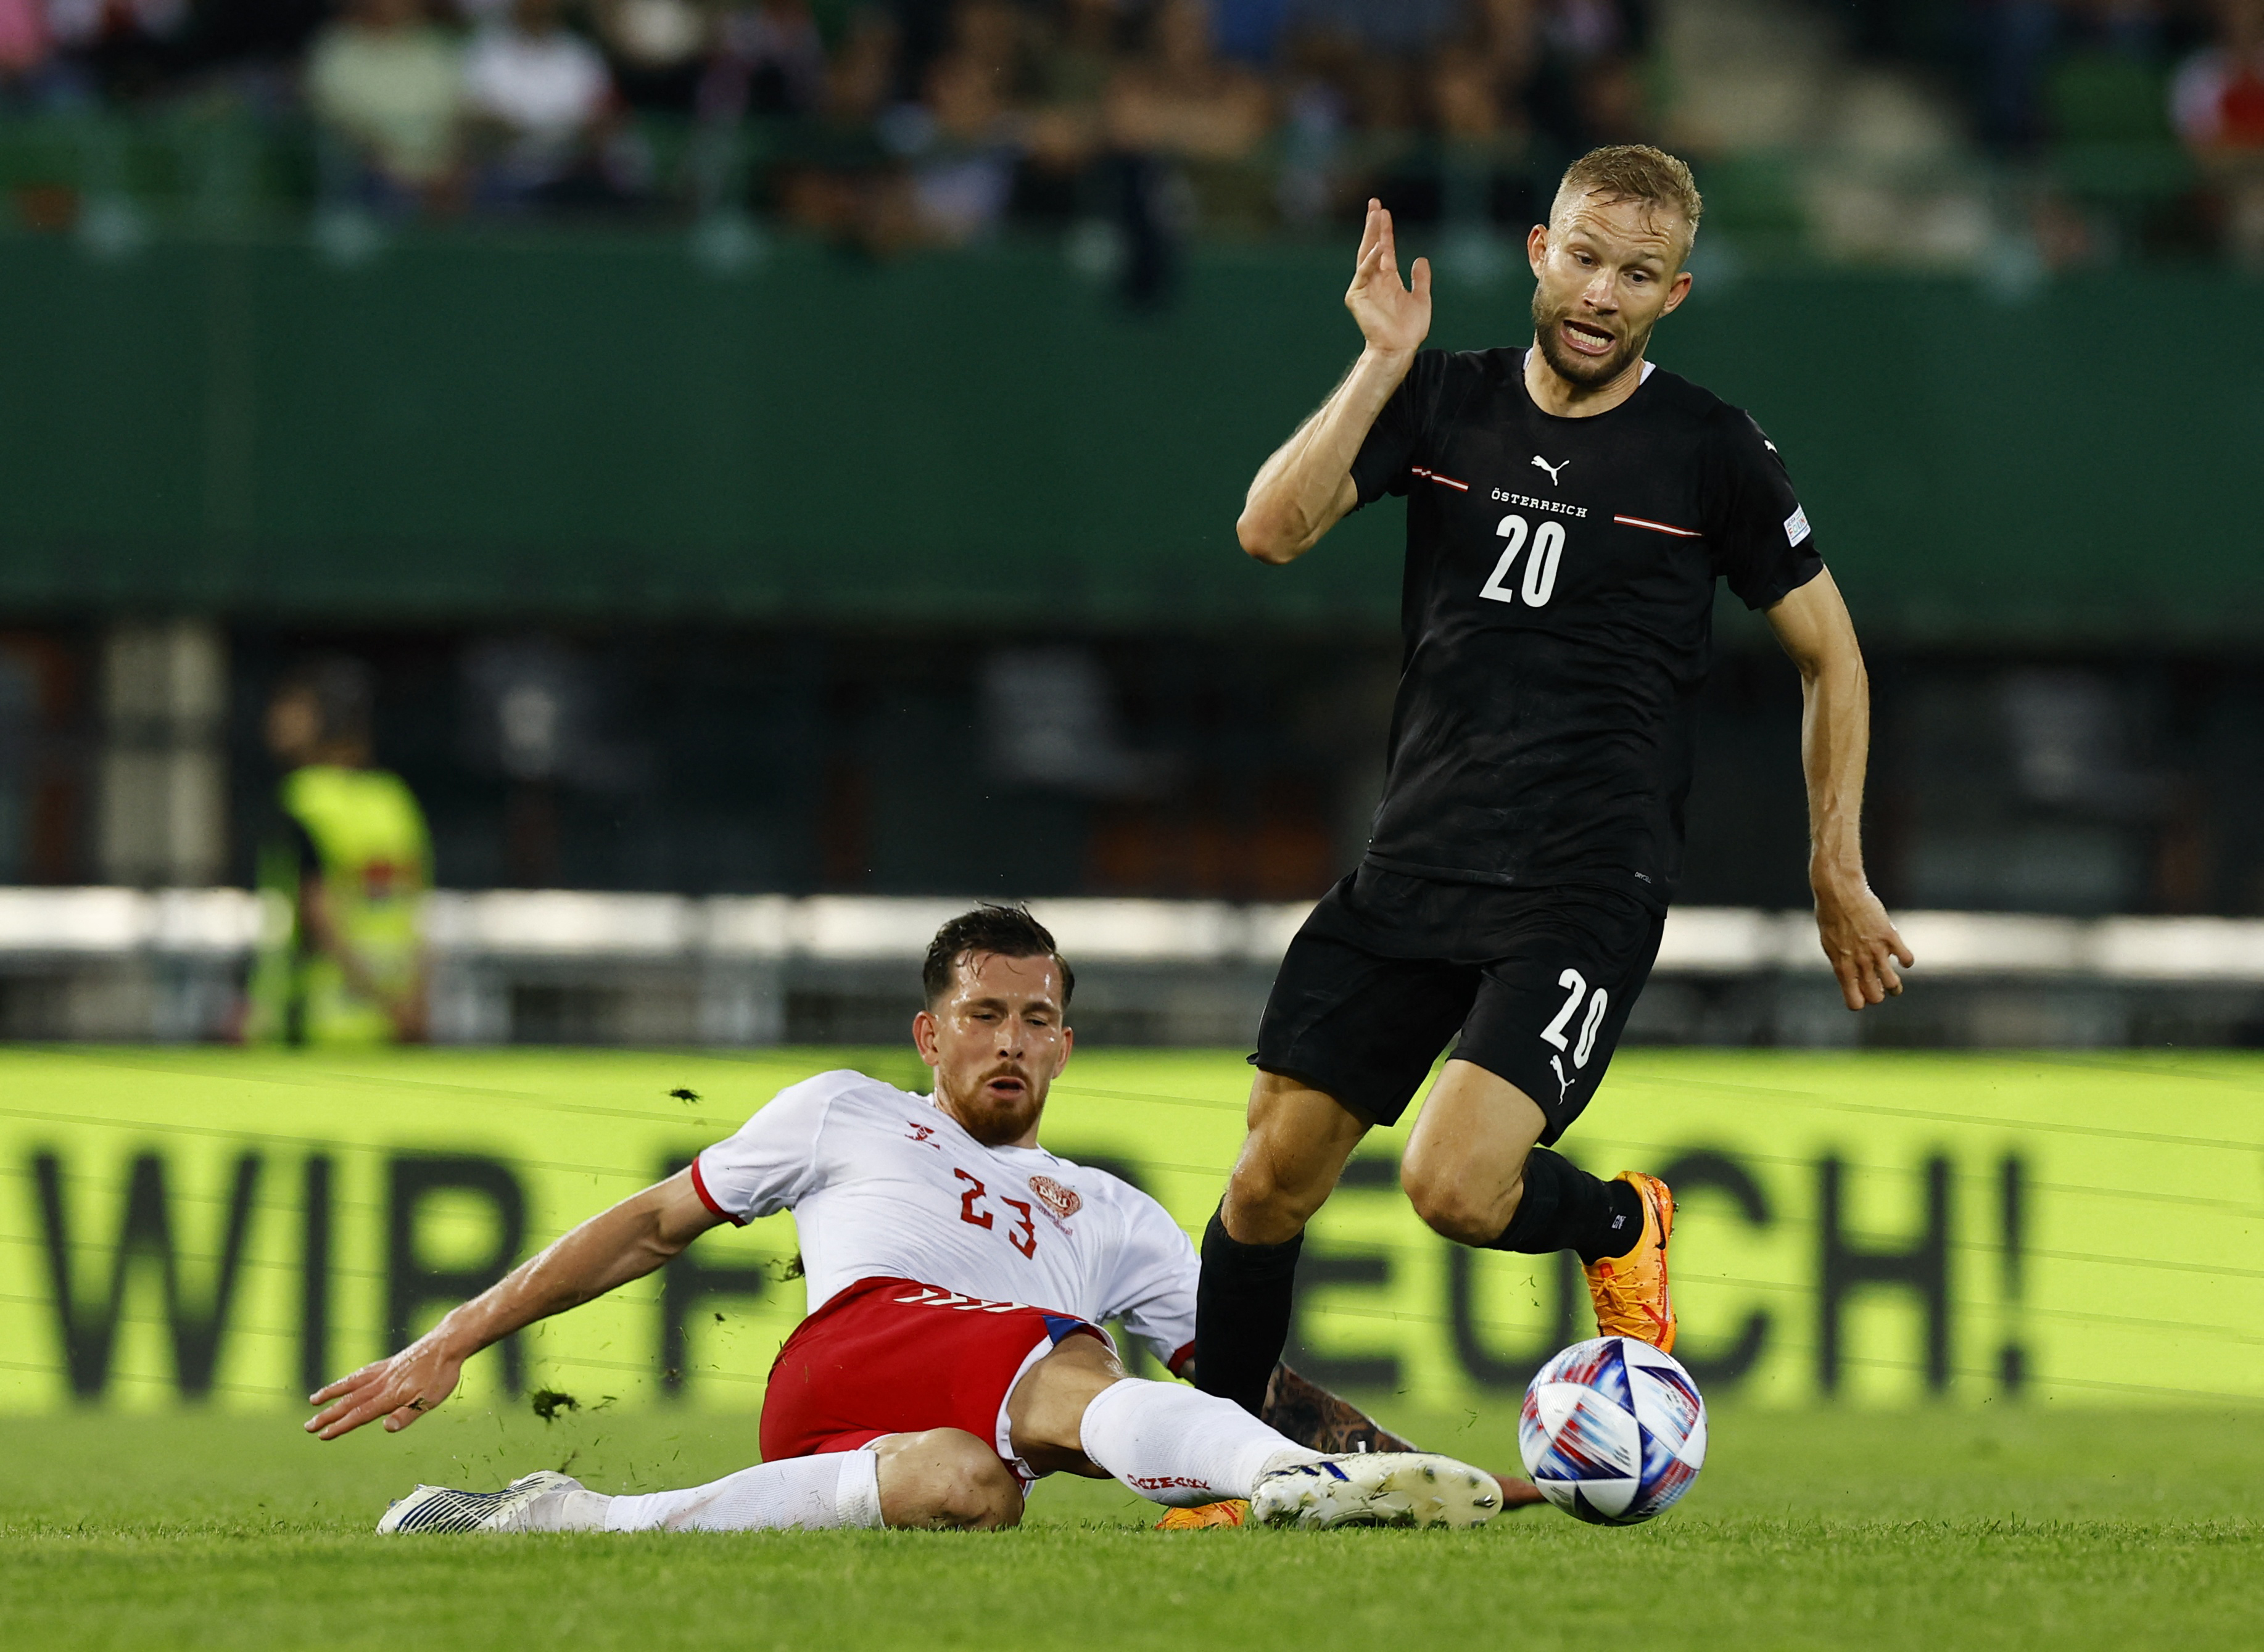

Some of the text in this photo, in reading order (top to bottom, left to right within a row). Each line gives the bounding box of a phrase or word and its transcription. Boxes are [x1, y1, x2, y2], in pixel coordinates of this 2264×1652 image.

[1490, 487, 1588, 518] ÖSTERREICH
[1479, 514, 1566, 608] 20
[1540, 968, 1608, 1070] 20
[953, 1167, 1038, 1260] 23
[30, 1146, 532, 1403] WIR
